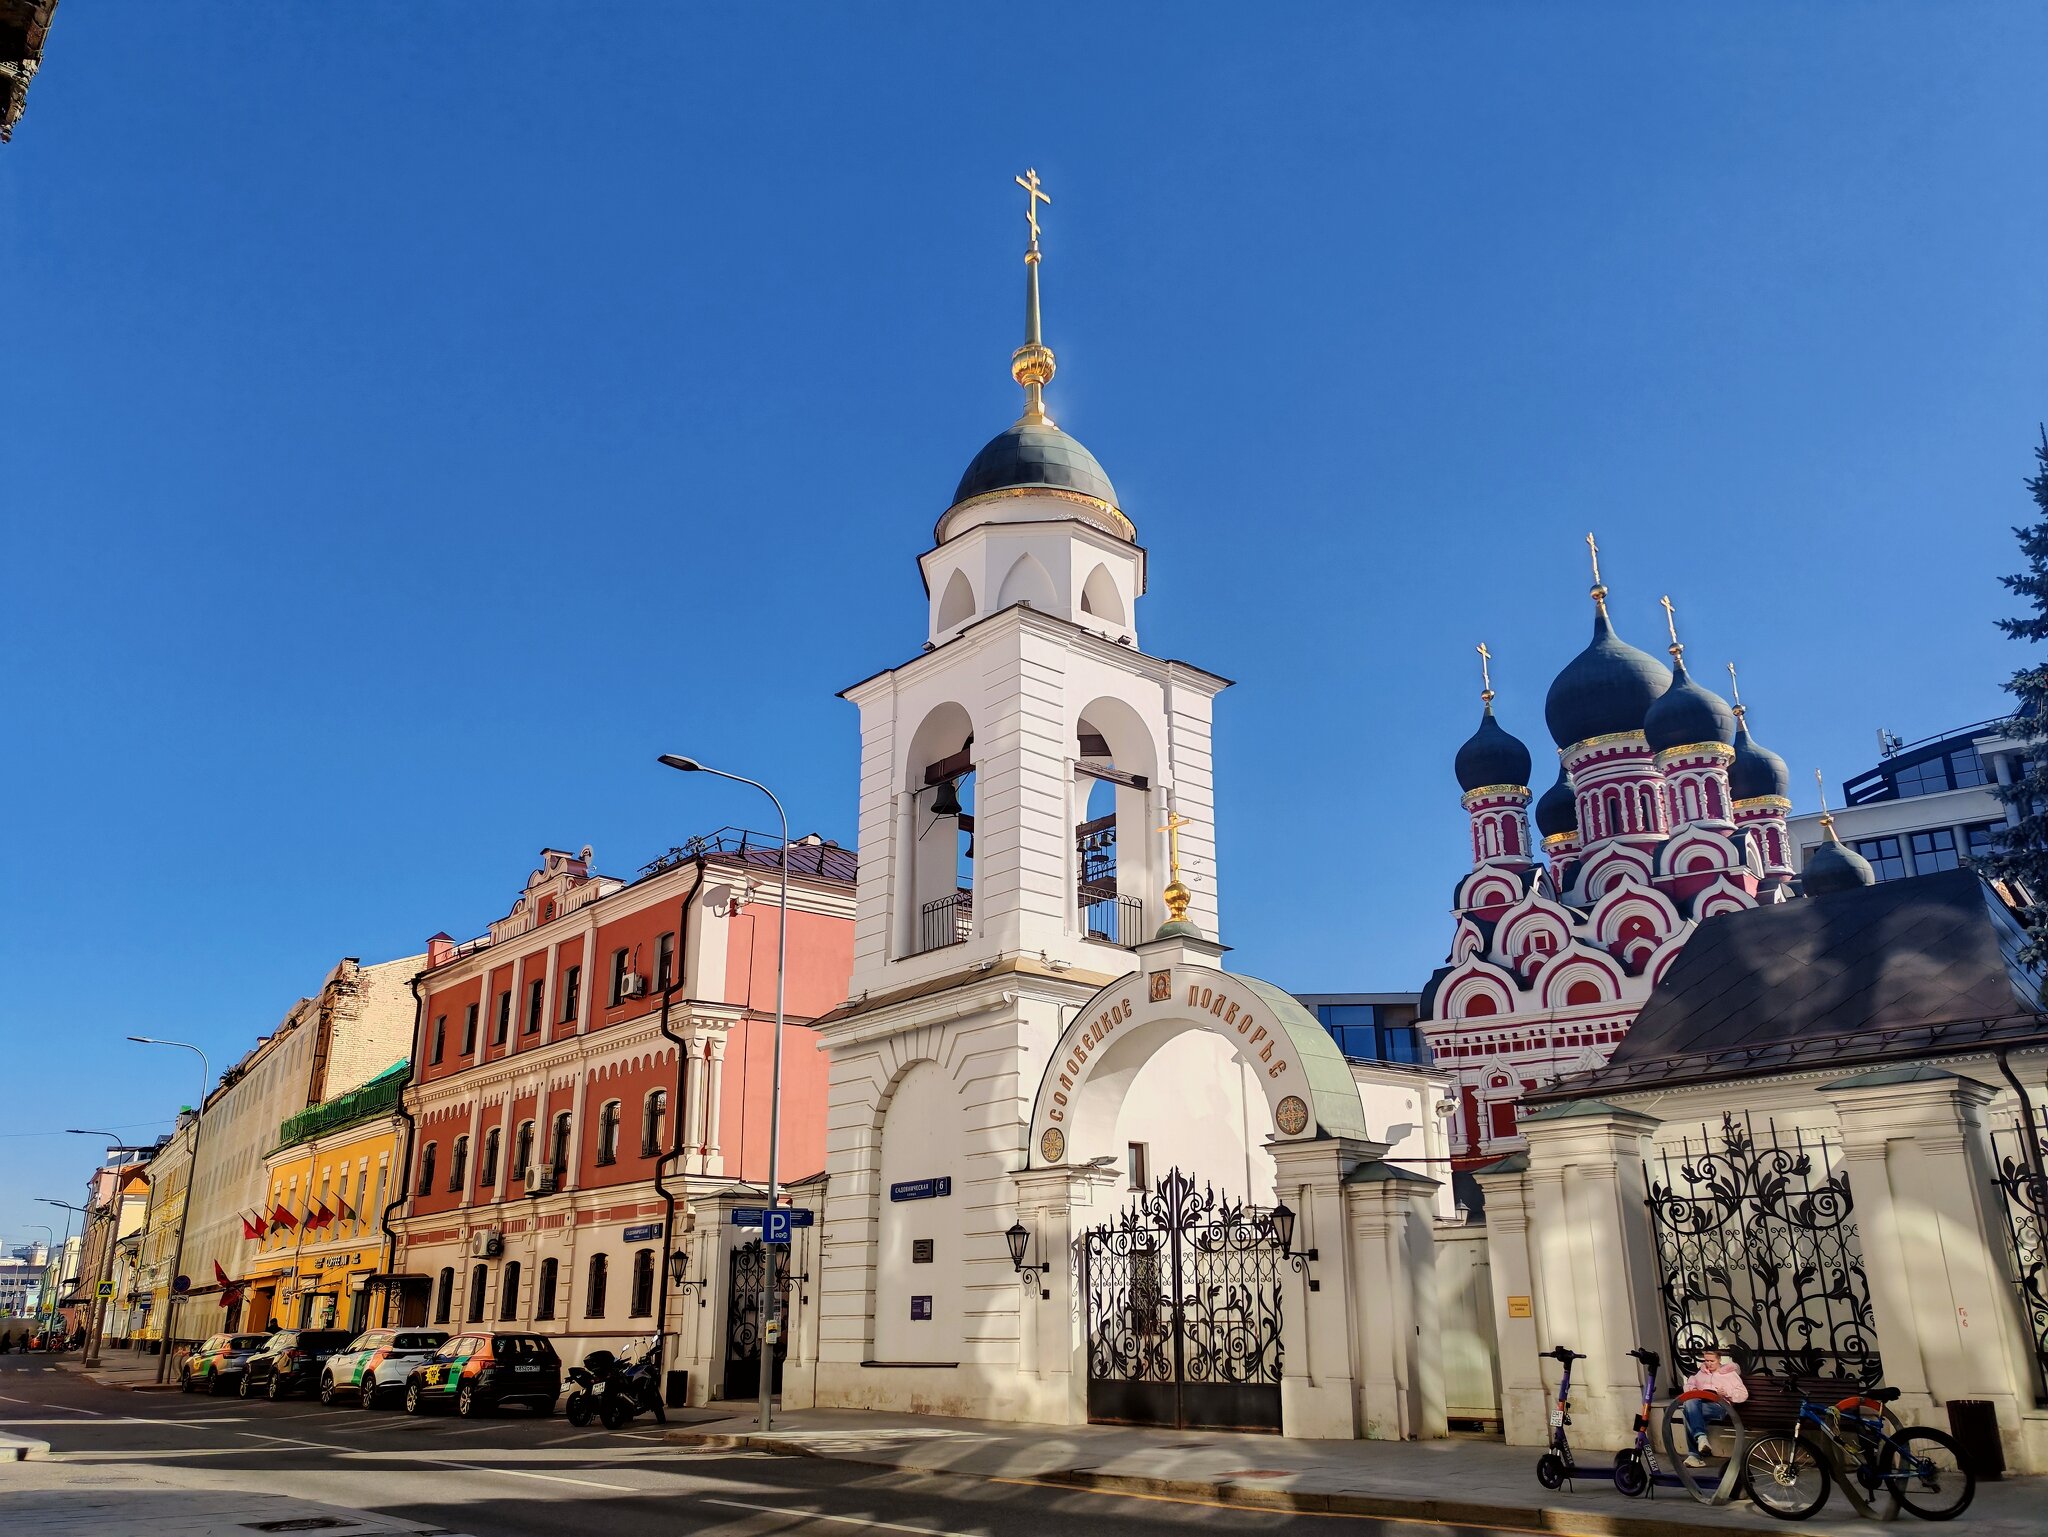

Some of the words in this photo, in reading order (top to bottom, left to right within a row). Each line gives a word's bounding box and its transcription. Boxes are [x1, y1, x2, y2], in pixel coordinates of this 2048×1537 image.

[1050, 997, 1133, 1123] СОЛОВЕЦКОЕ
[1187, 984, 1287, 1080] ПОДВОРЬЕ
[939, 1180, 944, 1190] 6
[770, 1213, 786, 1240] P
